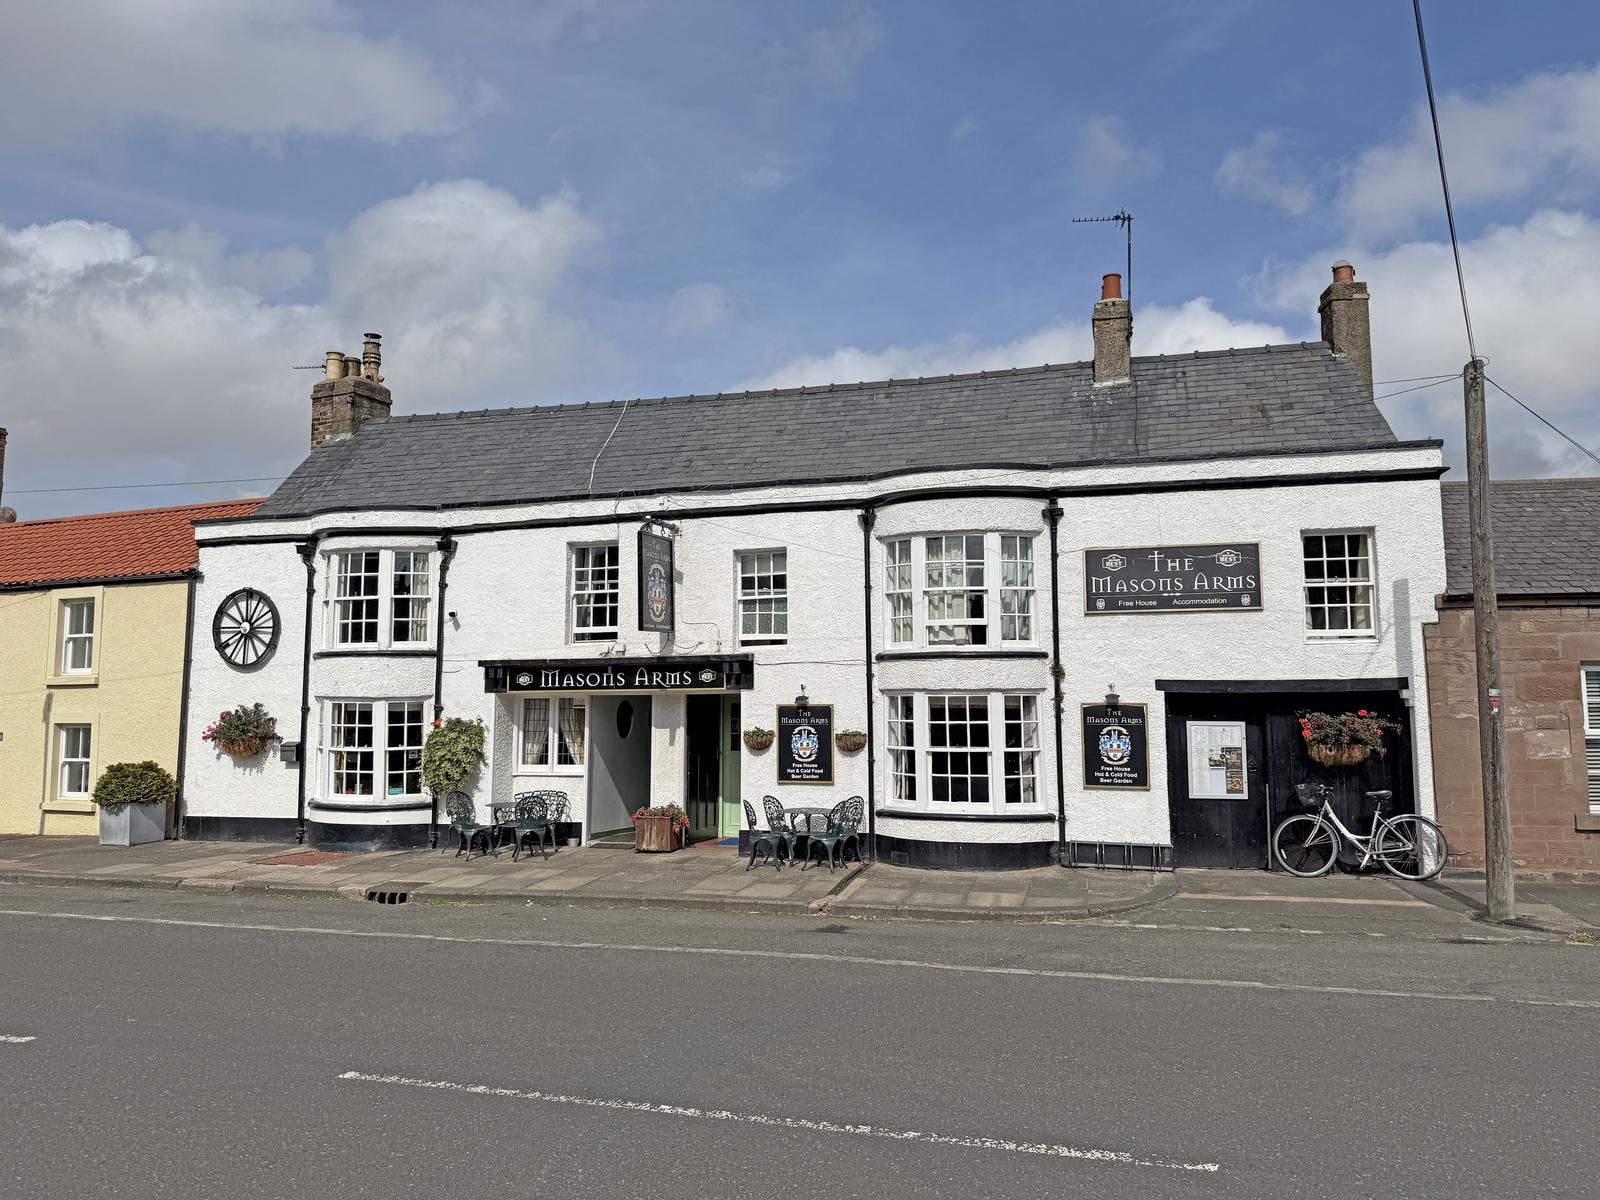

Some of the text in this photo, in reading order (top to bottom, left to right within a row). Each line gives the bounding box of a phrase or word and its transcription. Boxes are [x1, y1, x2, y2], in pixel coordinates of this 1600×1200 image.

[1148, 550, 1195, 572] THE
[1090, 572, 1256, 593] MASONS ARMS
[1135, 599, 1158, 607] House
[1172, 597, 1228, 606] Accommodation
[539, 667, 692, 688] MASONS ARMS
